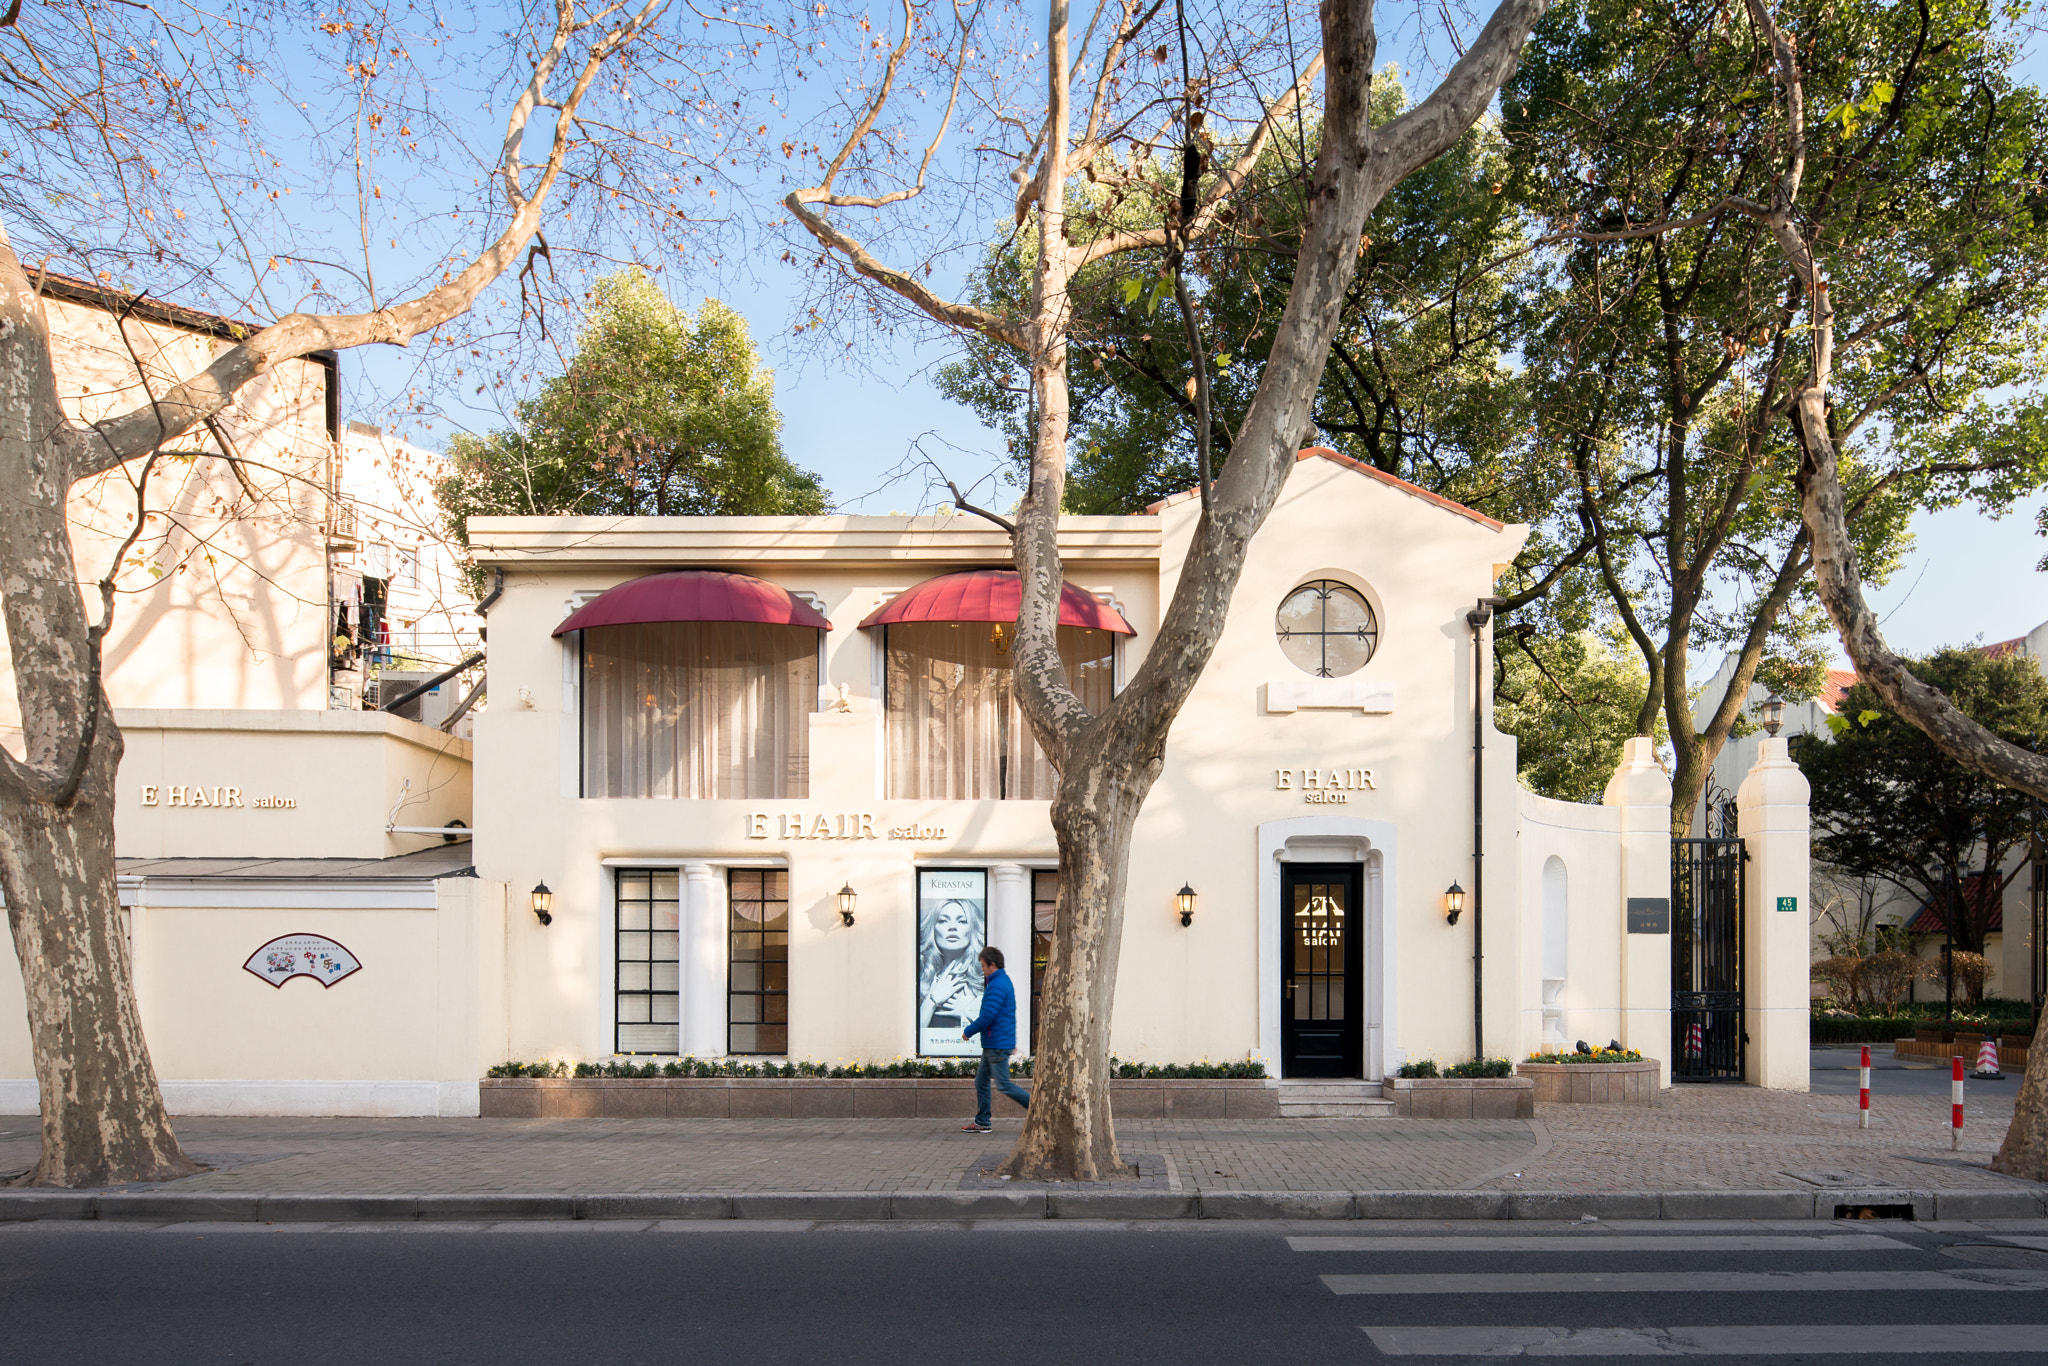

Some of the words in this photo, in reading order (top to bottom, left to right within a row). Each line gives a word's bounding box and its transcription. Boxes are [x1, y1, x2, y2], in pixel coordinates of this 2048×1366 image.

[1276, 768, 1293, 790] E
[1302, 768, 1376, 790] HAIR
[141, 785, 159, 806] E
[167, 785, 244, 807] HAIR
[252, 794, 296, 808] salon
[1306, 789, 1348, 803] salon
[749, 811, 770, 838] E
[782, 811, 880, 839] HAIR
[893, 821, 948, 839] salon
[1782, 898, 1792, 907] 45
[1303, 936, 1338, 946] salon
